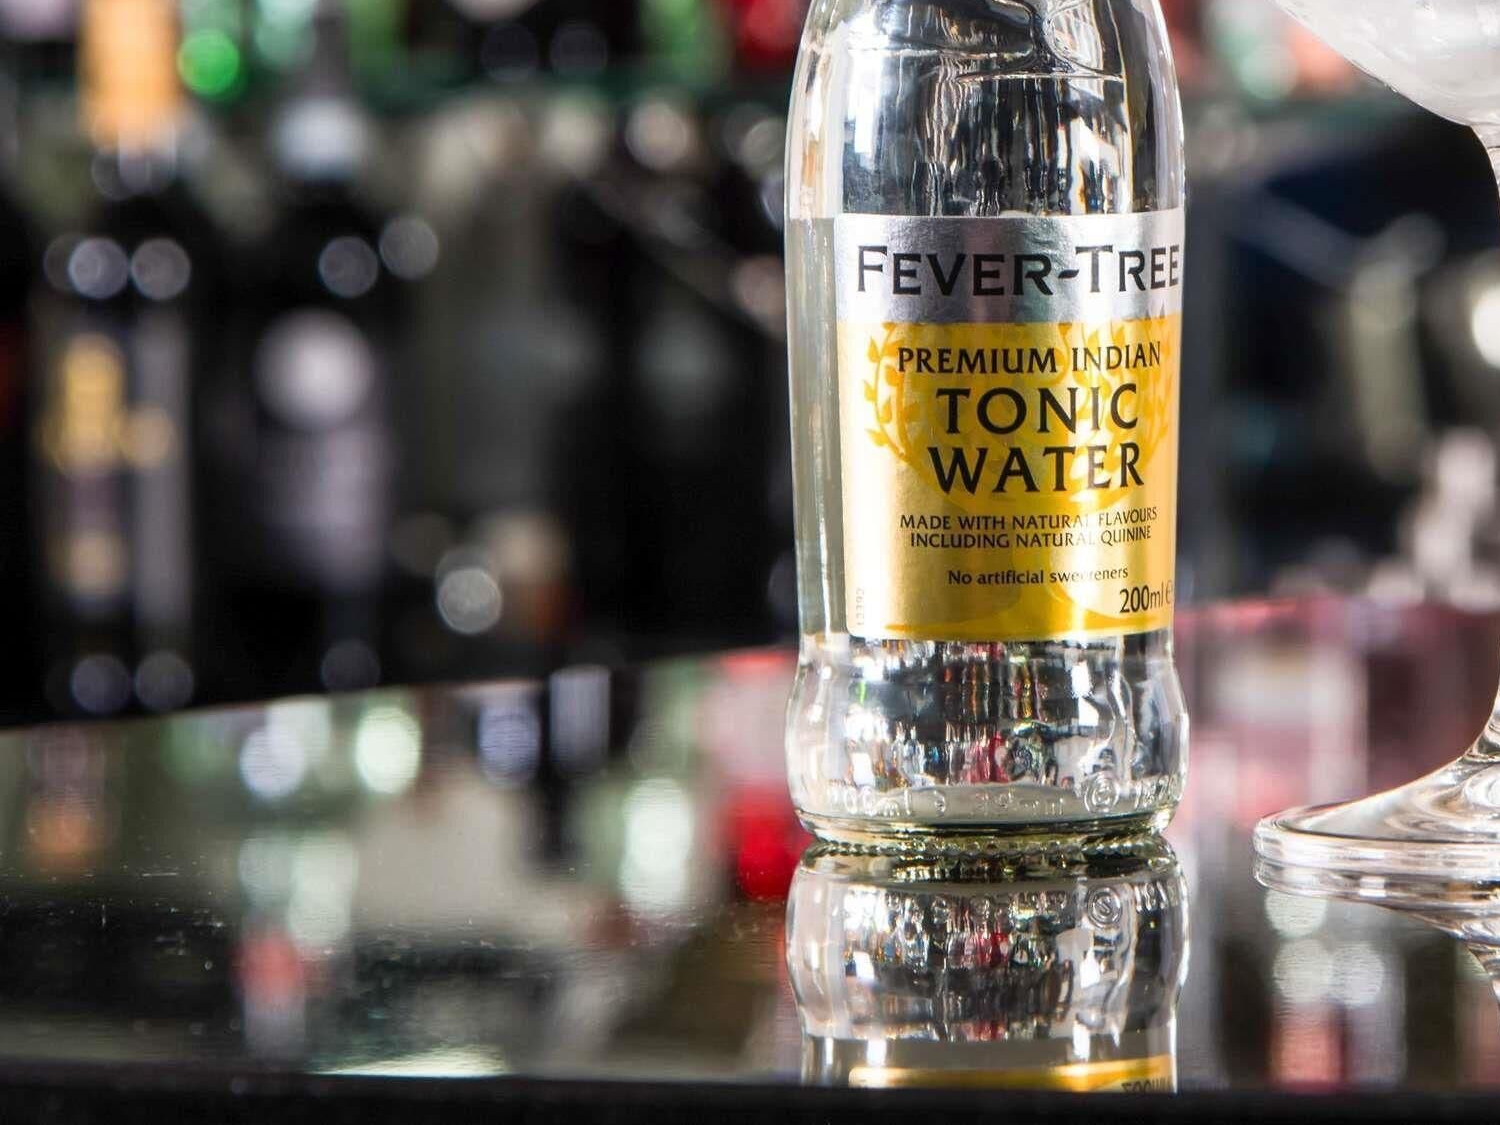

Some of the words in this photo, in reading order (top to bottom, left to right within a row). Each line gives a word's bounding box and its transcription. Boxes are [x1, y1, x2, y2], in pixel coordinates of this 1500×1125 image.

[898, 346, 1057, 374] PREMIUM
[1072, 340, 1161, 372] INDIAN
[936, 383, 1139, 435] TONIC
[927, 442, 1145, 495] WATER
[900, 515, 951, 530] MADE
[957, 515, 1008, 531] WITH
[1098, 506, 1158, 527] FLAVOURS
[911, 533, 1010, 549] INCLUDING
[1016, 532, 1096, 548] NATURAL
[1101, 525, 1152, 547] QUININE
[948, 570, 972, 585] No
[976, 568, 1044, 585] artificial
[1050, 567, 1129, 584] sweeners
